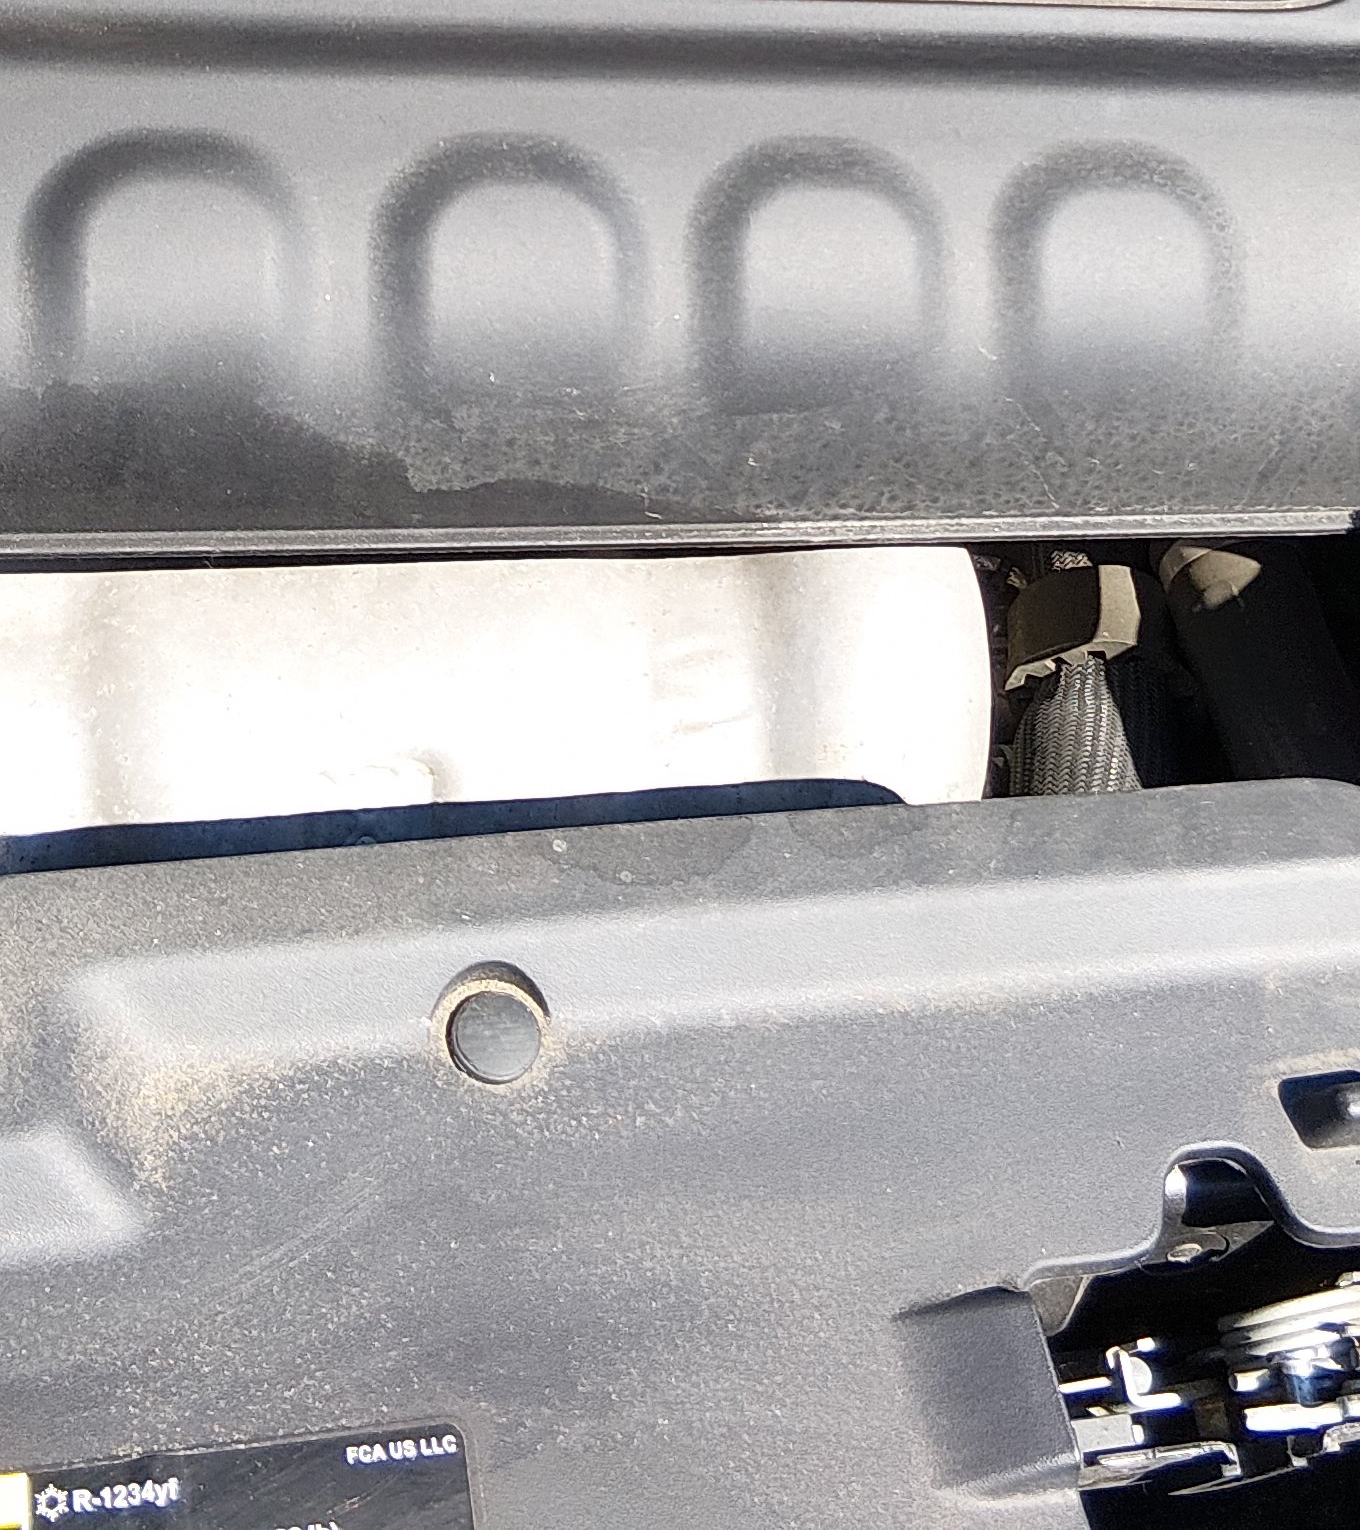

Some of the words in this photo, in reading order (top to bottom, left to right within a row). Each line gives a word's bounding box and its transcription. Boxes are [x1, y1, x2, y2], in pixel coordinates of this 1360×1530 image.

[345, 1443, 389, 1465] FCA
[390, 1439, 419, 1461] US
[419, 1434, 459, 1457] LLC
[71, 1475, 183, 1515] R-1234yf
